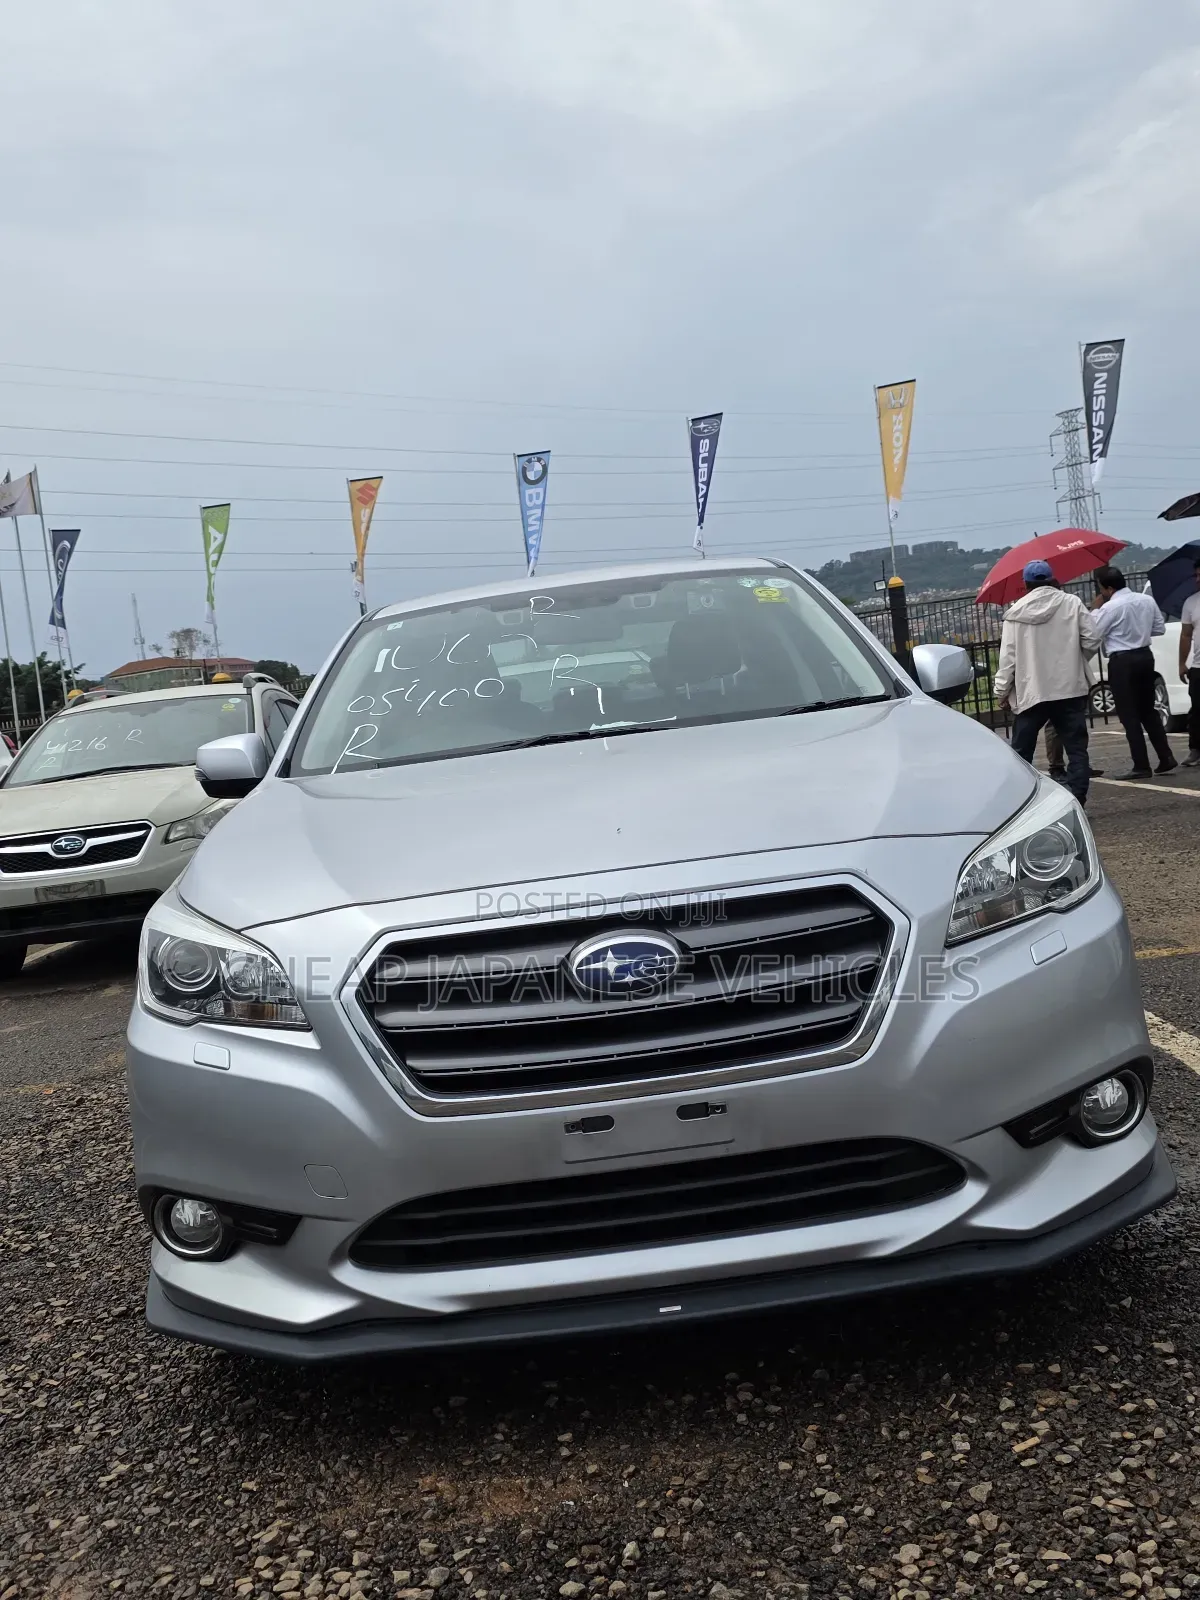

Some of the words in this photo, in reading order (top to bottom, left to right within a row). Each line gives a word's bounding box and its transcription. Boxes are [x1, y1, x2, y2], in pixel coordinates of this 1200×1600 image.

[1092, 371, 1108, 461] NISSAN
[529, 596, 580, 621] R
[549, 653, 600, 691] R
[124, 728, 144, 744] R
[330, 723, 385, 775] R
